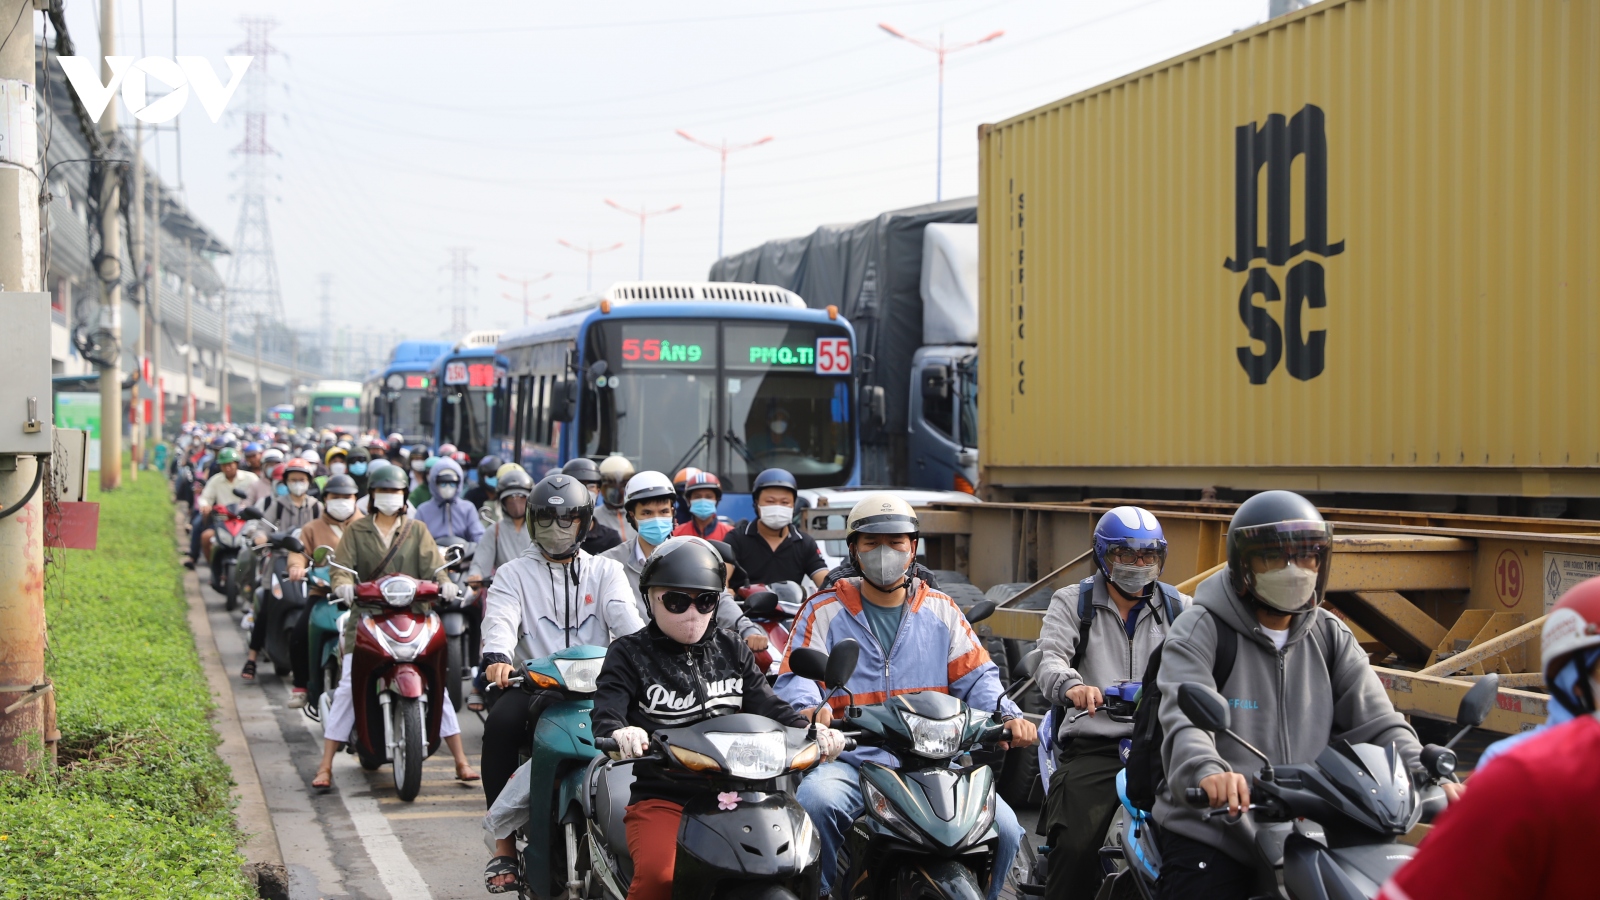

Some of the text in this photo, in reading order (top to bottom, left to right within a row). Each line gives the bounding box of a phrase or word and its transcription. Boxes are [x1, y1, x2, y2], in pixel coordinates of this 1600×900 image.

[818, 339, 851, 373] 55
[1497, 558, 1521, 599] 19
[853, 825, 870, 841] HONDA
